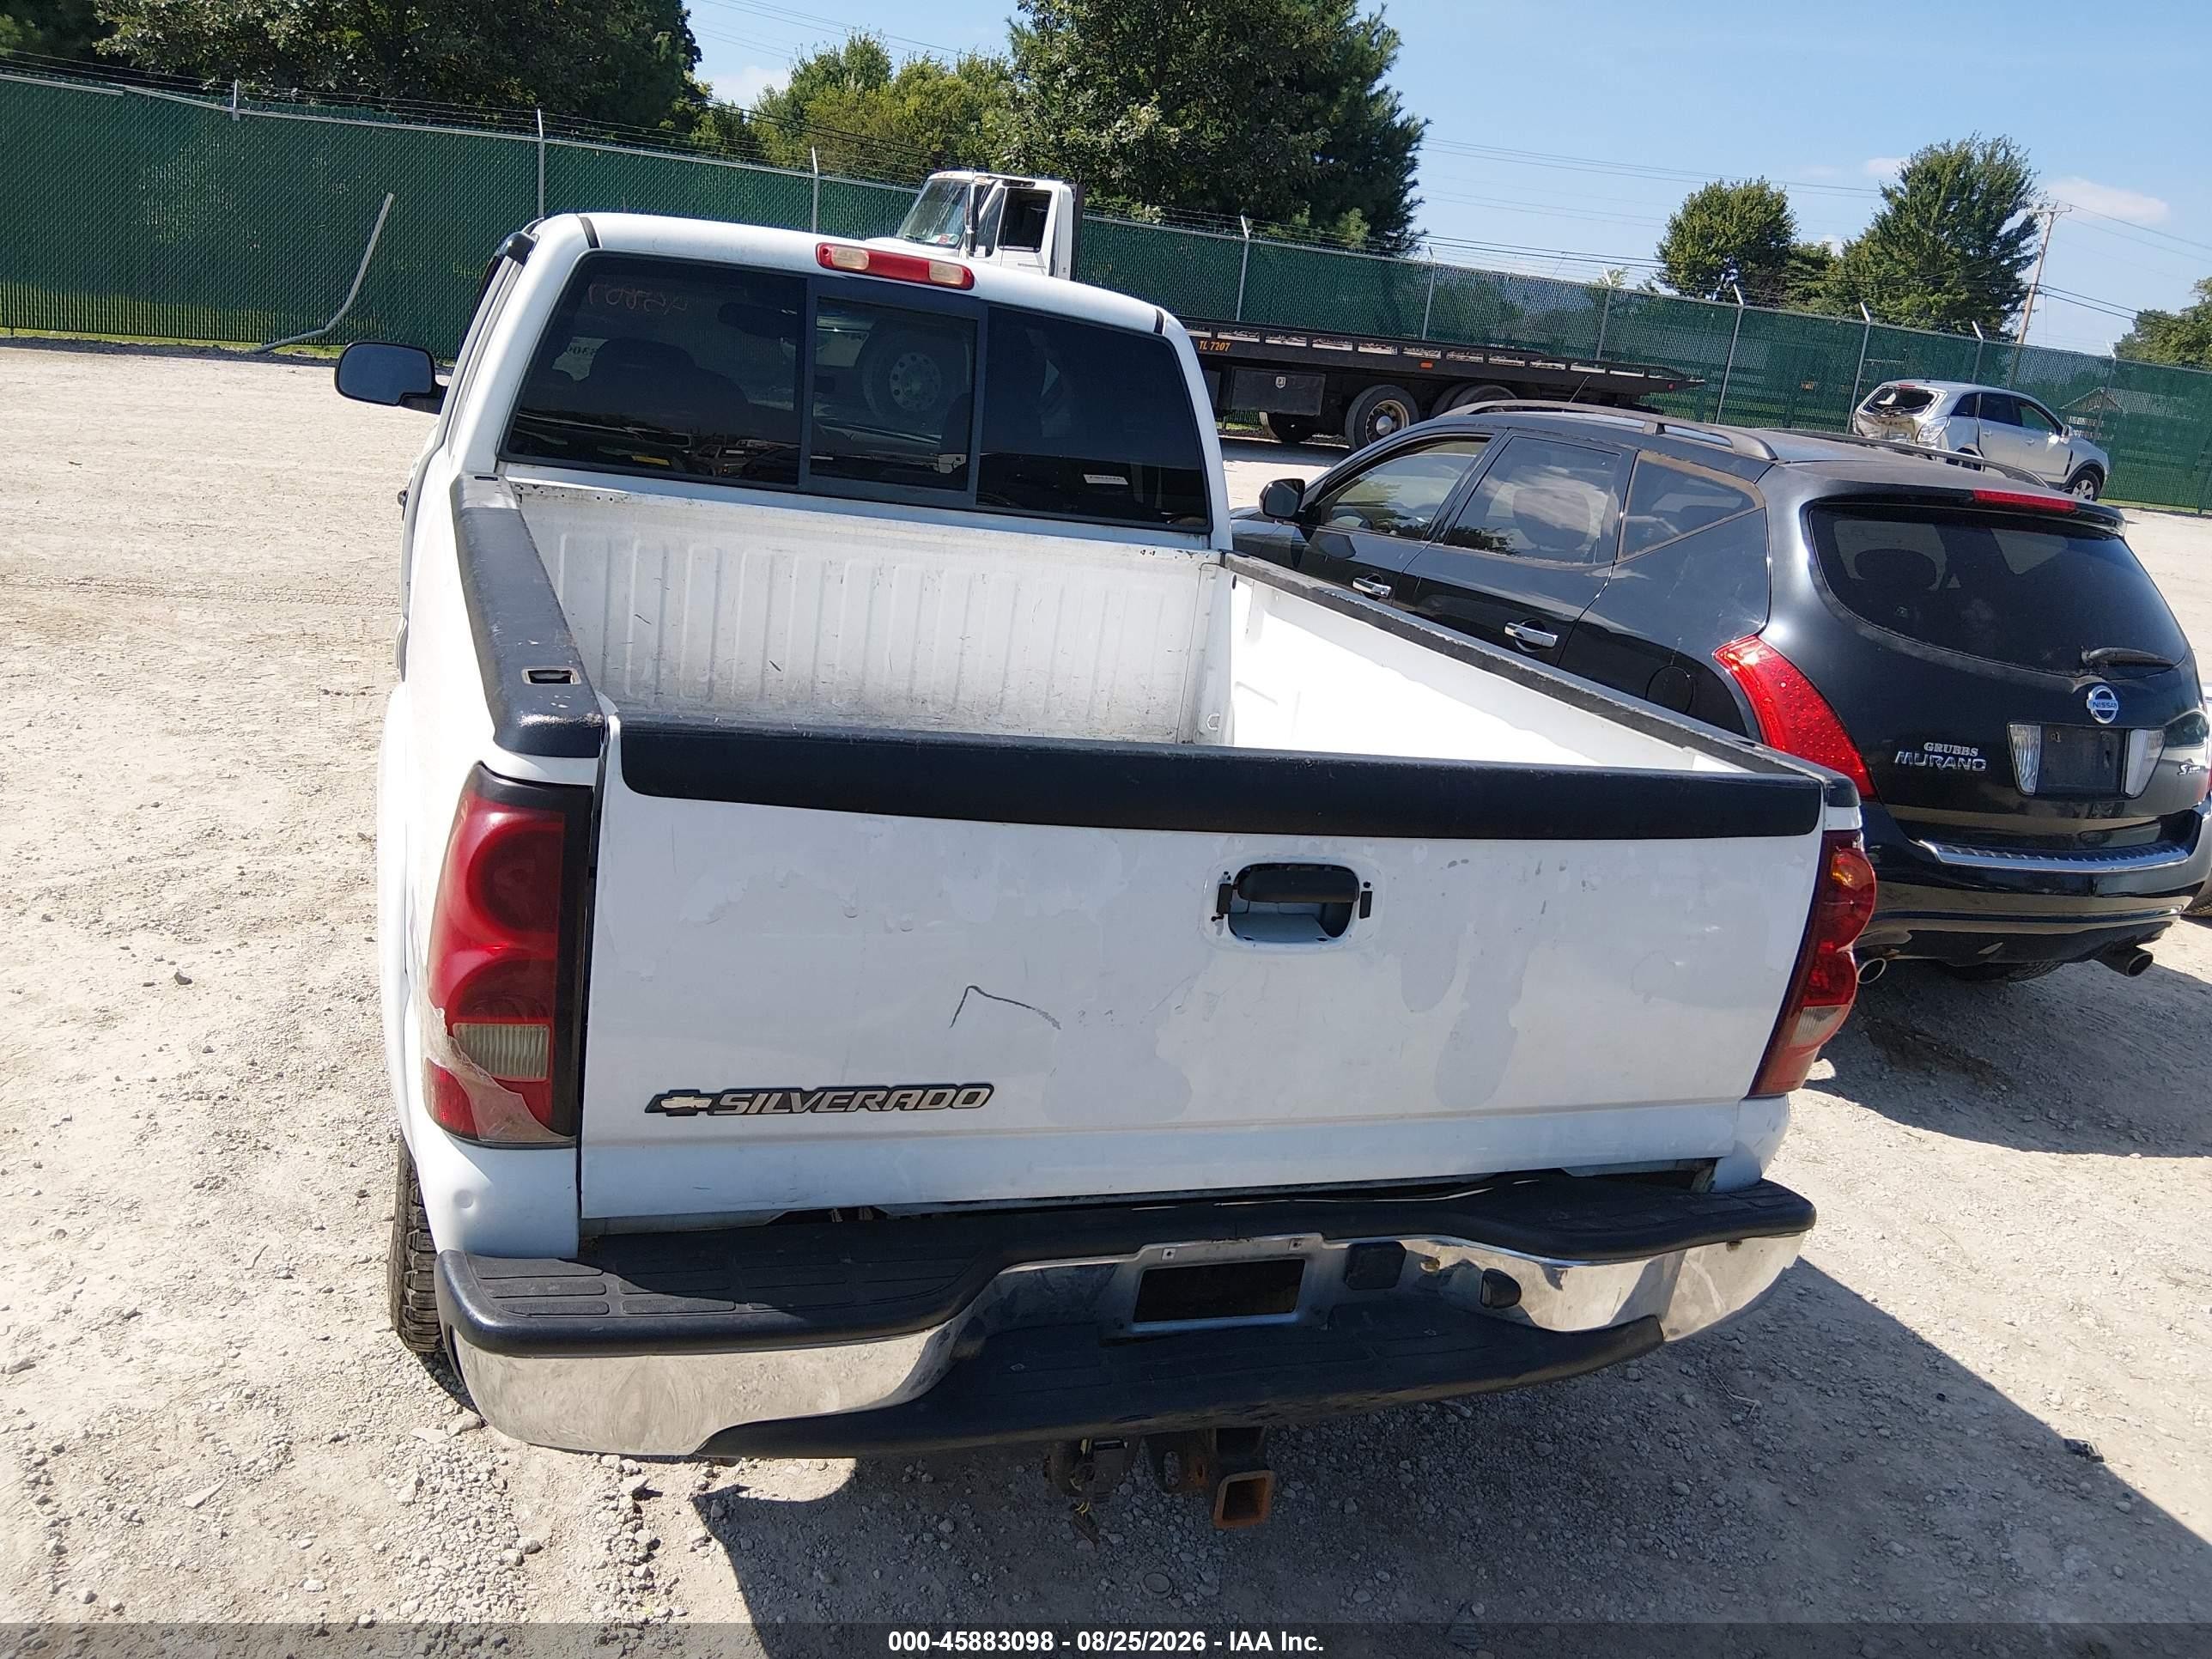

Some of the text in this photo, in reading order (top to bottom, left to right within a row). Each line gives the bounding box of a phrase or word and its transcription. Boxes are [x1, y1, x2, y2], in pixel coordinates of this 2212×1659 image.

[1199, 340, 1231, 352] TL 7207
[2092, 701, 2118, 709] NISSAN
[1923, 741, 1979, 757] GRUBBS
[1894, 750, 1987, 772] MURANO
[712, 1086, 992, 1115] SILVERADO
